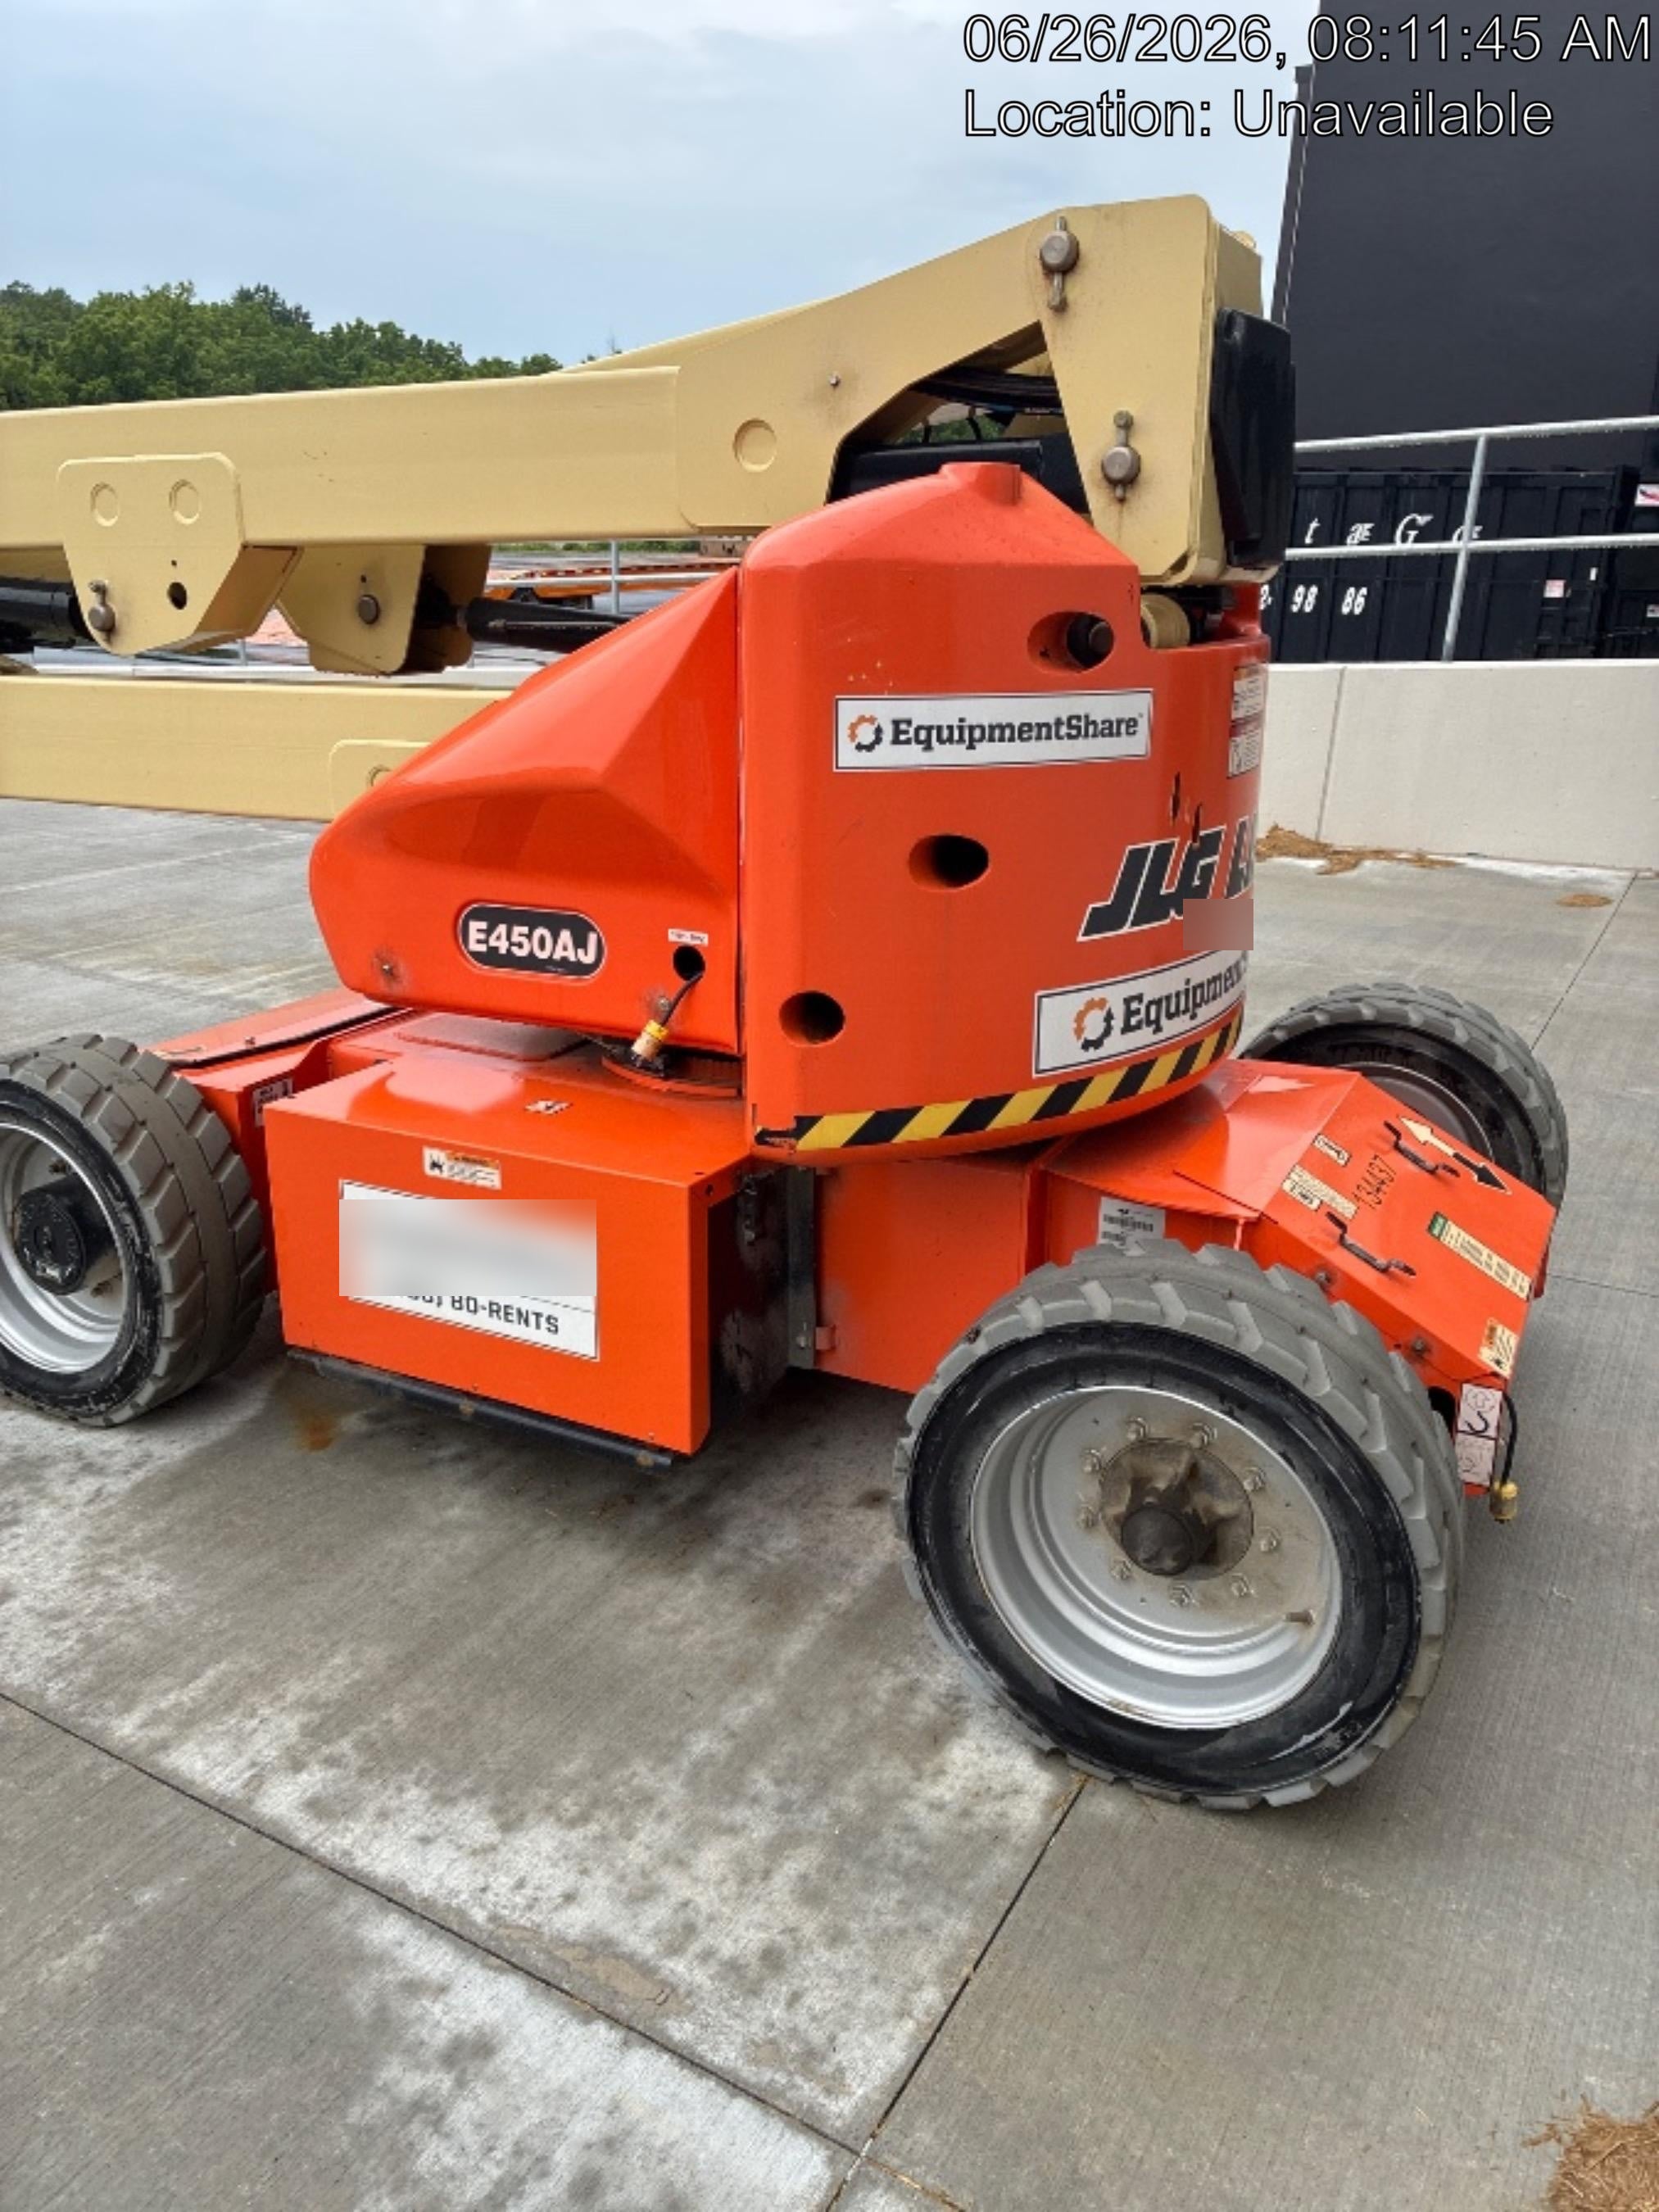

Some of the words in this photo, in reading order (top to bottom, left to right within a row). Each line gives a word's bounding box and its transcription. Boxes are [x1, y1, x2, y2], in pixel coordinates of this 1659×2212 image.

[890, 714, 1140, 751] EquipmentShare
[1077, 824, 1226, 942] JLG
[468, 920, 598, 964] E450AJ
